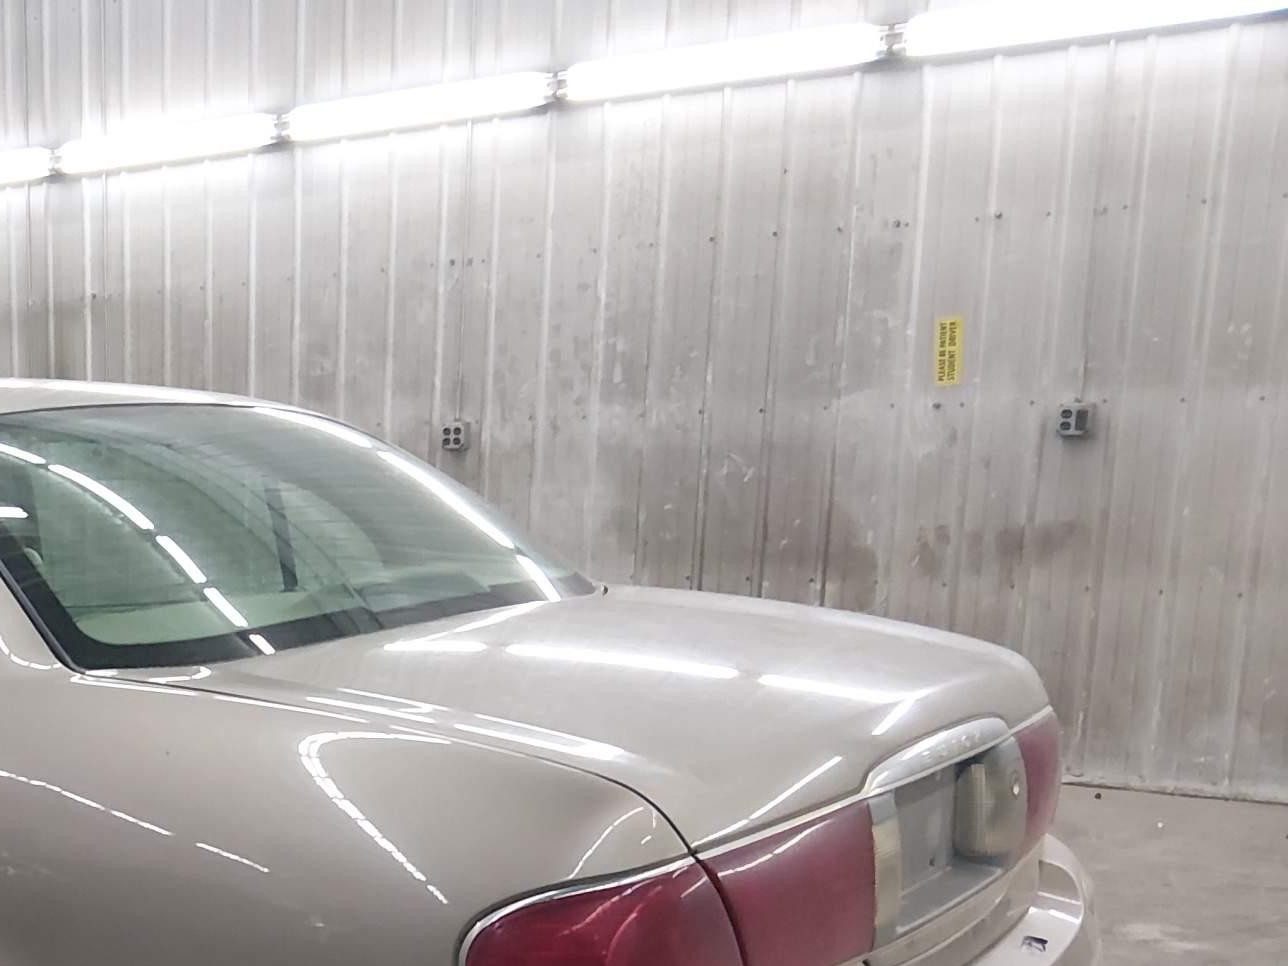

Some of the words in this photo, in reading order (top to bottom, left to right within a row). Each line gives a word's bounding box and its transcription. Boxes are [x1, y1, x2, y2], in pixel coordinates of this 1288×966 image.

[939, 322, 948, 348] PATIENT
[948, 321, 957, 346] DRIVER
[938, 359, 946, 381] PLEASE
[947, 350, 956, 380] STUDENT
